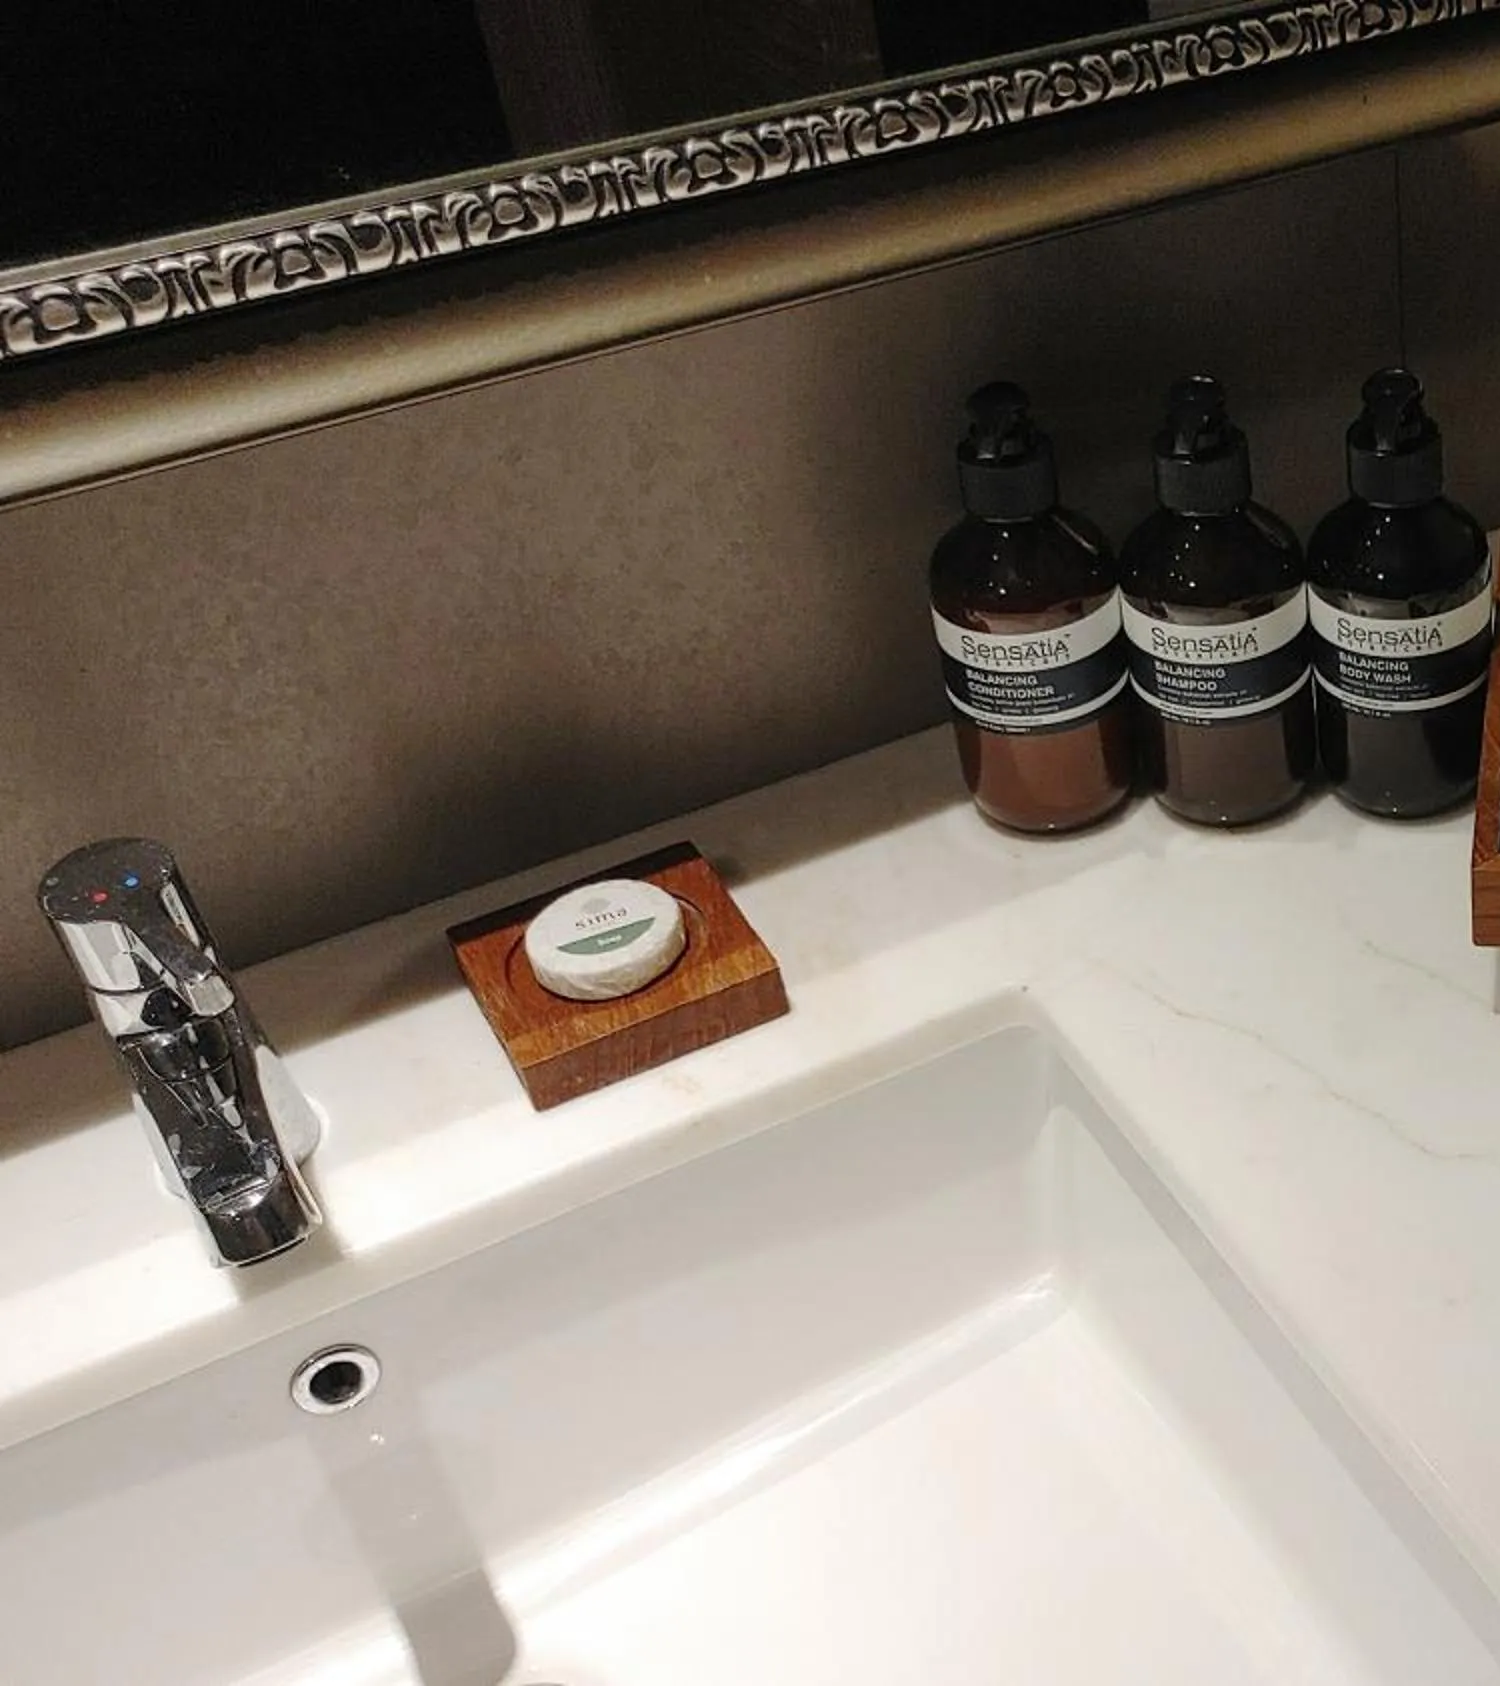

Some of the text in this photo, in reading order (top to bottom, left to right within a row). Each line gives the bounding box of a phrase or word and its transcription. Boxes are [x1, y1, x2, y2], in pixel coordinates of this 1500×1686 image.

[1154, 661, 1226, 680] BALANCING
[1339, 651, 1409, 672] BALANCING
[965, 669, 1038, 686] BALANCING
[1156, 674, 1218, 691] SHAMPOO
[1339, 664, 1370, 681] BODY
[1373, 673, 1411, 684] WASH
[967, 681, 1055, 699] CONDITIONER
